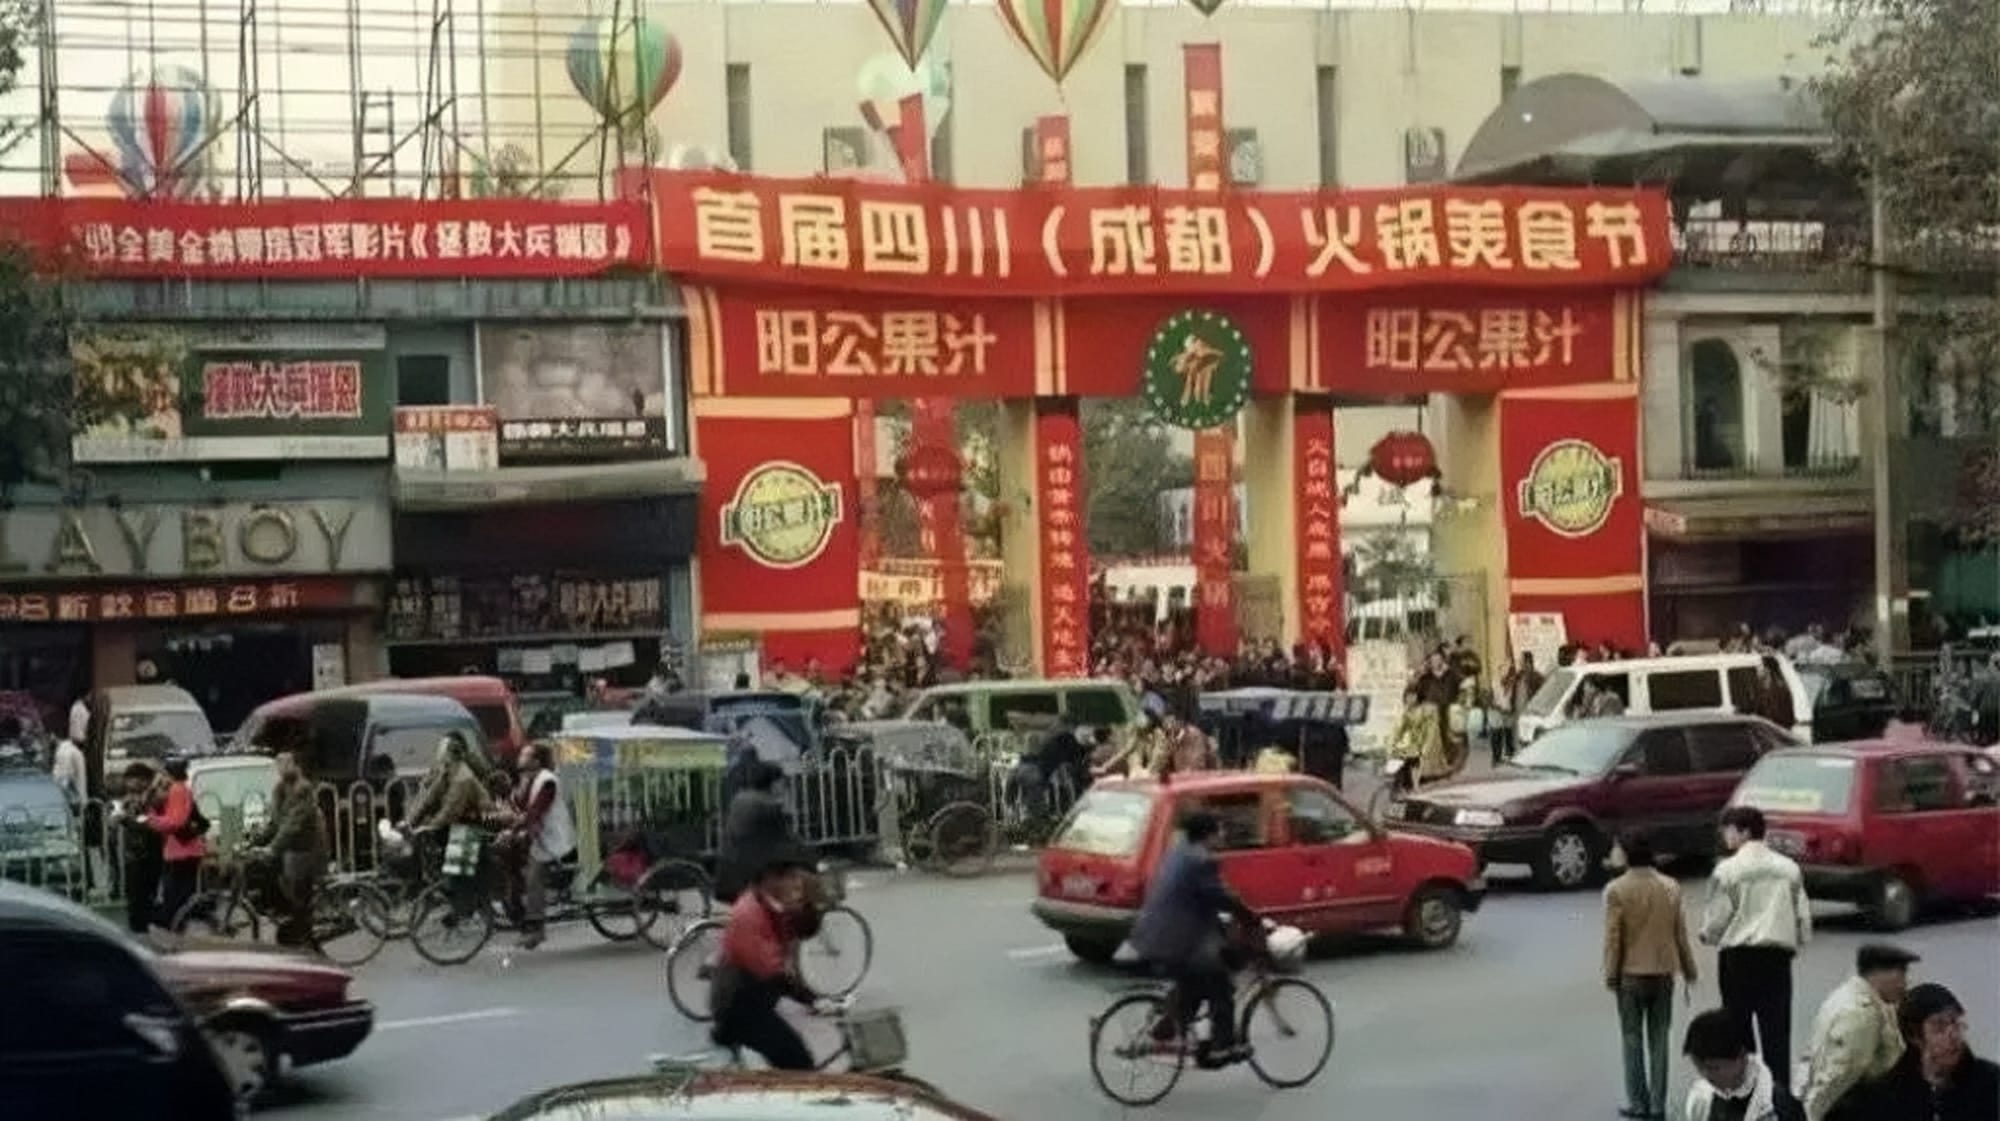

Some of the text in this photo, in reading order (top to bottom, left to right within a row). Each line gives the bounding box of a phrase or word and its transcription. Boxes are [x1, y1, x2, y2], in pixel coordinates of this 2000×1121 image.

[693, 186, 1648, 278] 首届四川（成都）火锅美食节
[755, 309, 997, 376] 阳公果汁
[1364, 307, 1583, 370] 阳公果汁
